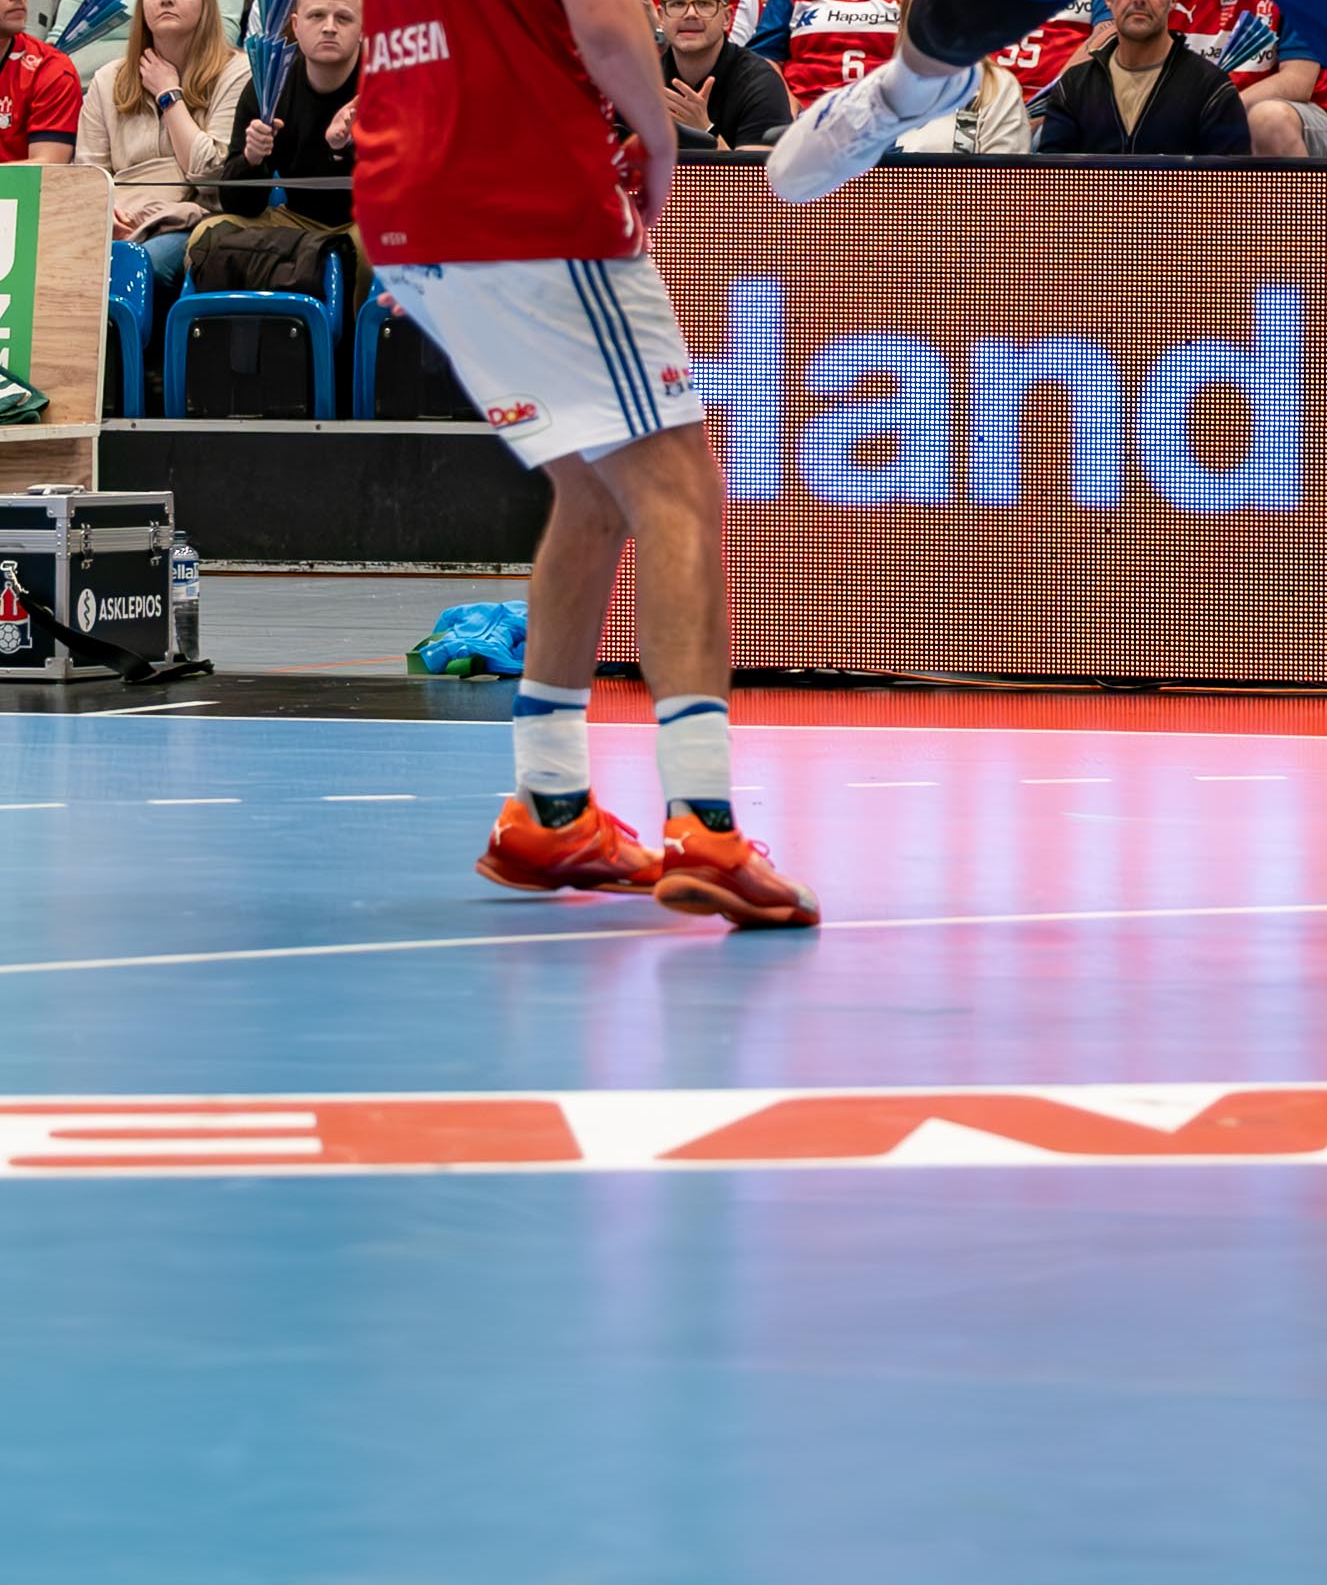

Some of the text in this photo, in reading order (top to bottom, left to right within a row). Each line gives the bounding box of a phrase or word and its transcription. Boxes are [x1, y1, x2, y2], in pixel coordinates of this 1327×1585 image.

[842, 49, 866, 82] 6
[487, 401, 539, 426] Dole
[99, 594, 162, 621] ASKLEPIOS
